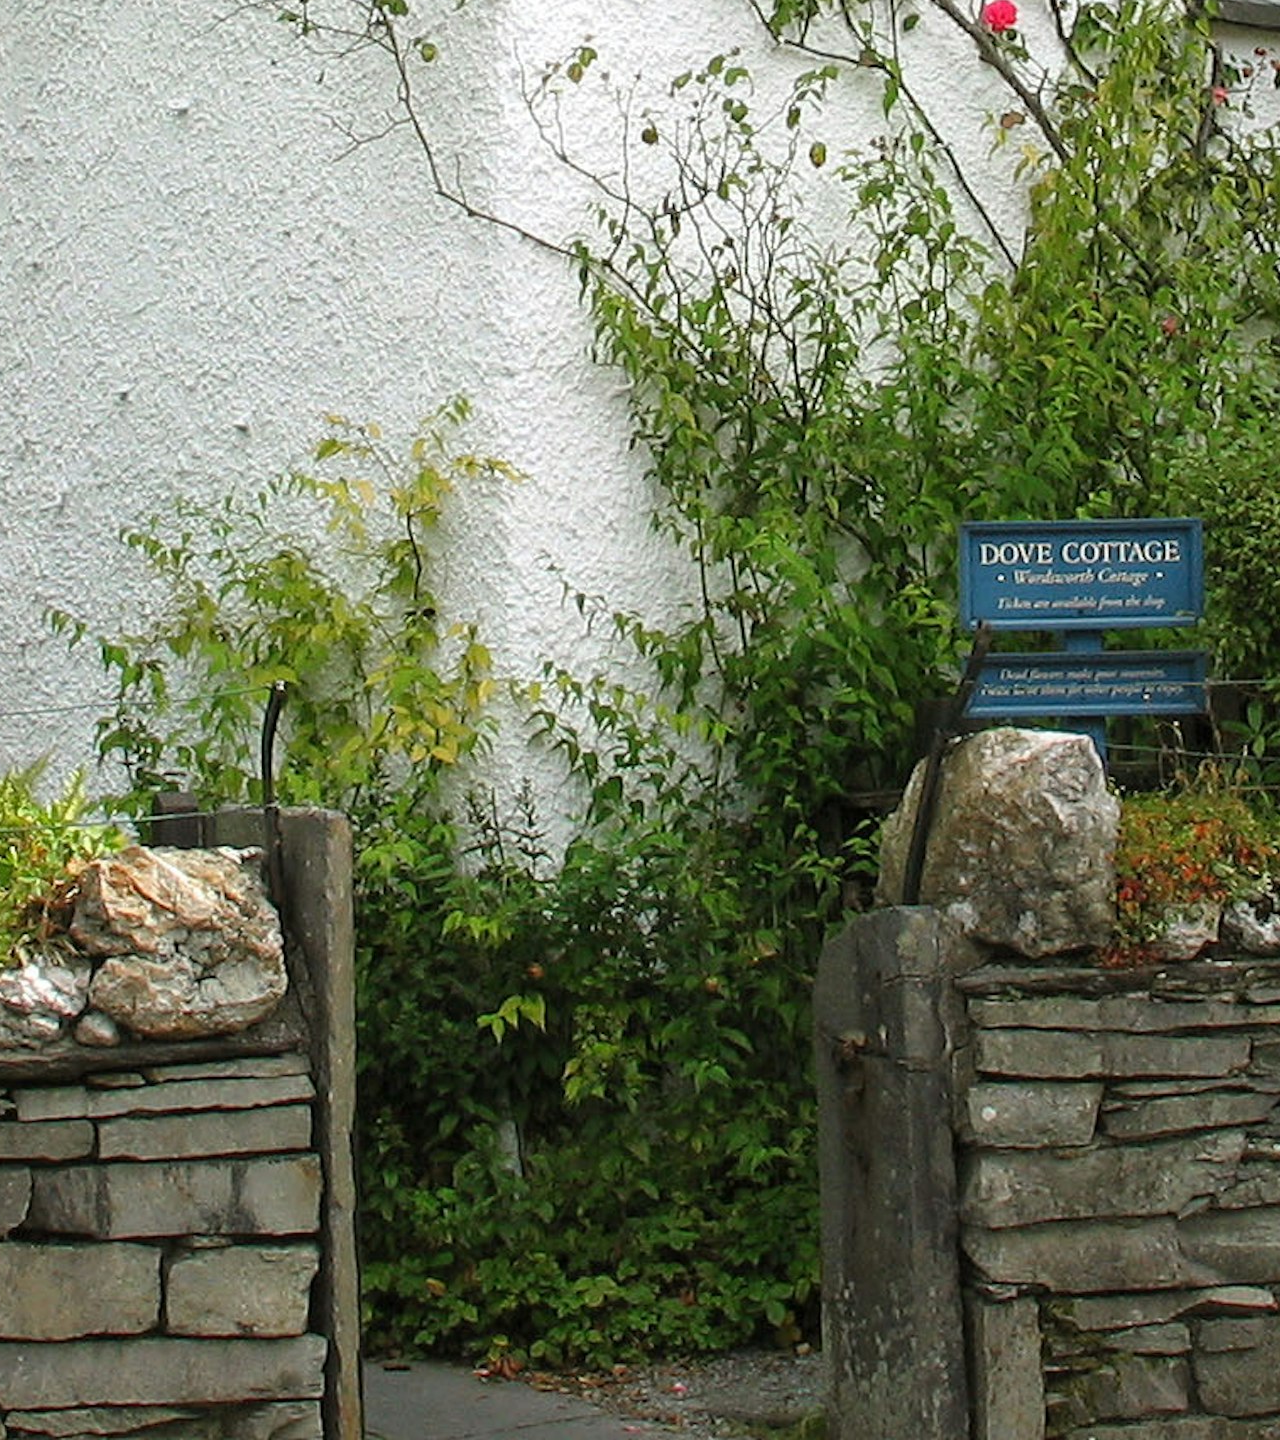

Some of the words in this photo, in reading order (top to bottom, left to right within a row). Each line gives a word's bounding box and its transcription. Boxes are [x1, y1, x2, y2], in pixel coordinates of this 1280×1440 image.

[980, 543, 1054, 566] DOVE
[1061, 540, 1181, 564] COTTAGE
[1014, 567, 1095, 585] Wordsworth
[1098, 567, 1149, 588] Cottage
[1033, 600, 1050, 609] are
[1098, 594, 1123, 611] from
[1124, 594, 1141, 608] the
